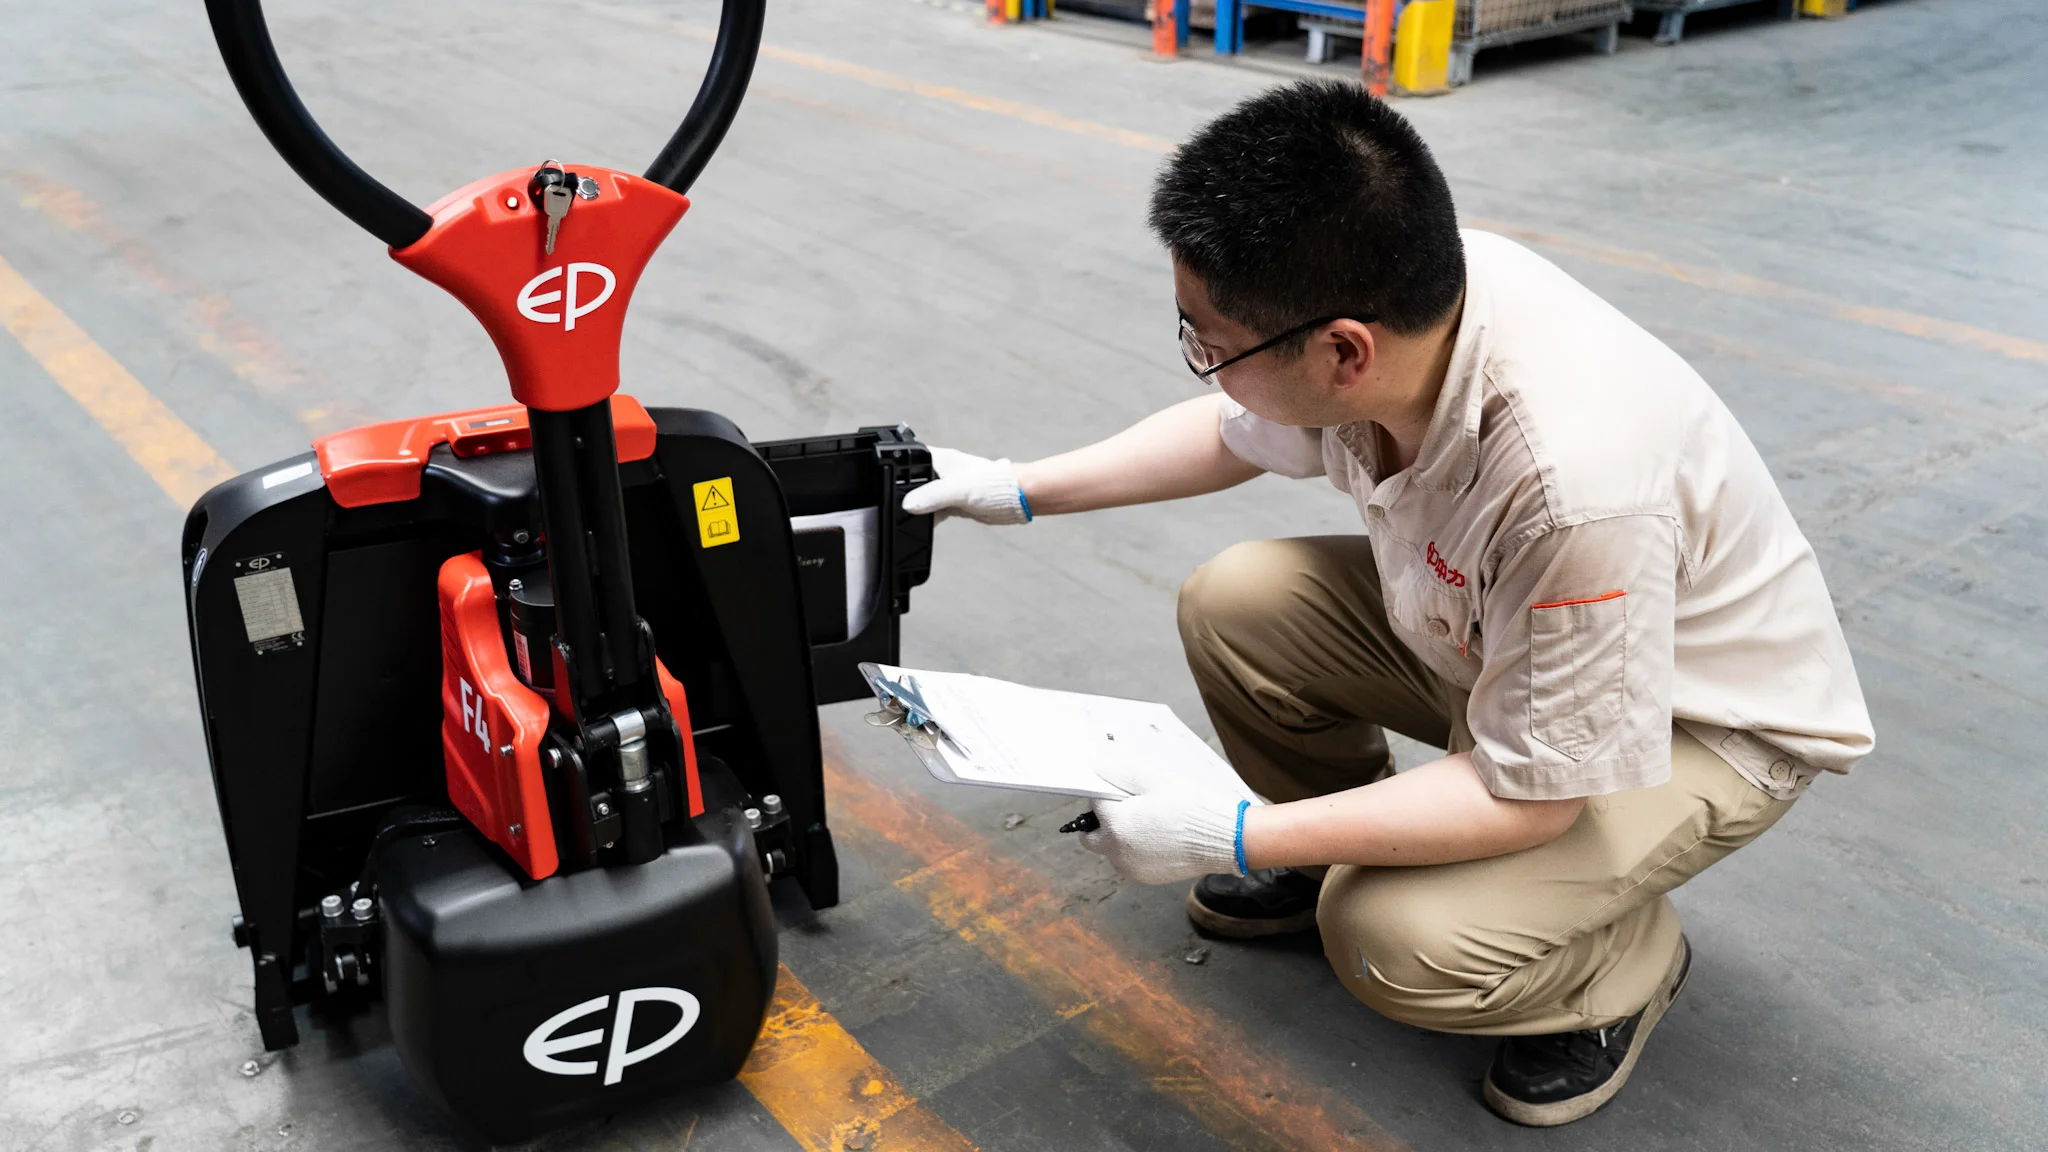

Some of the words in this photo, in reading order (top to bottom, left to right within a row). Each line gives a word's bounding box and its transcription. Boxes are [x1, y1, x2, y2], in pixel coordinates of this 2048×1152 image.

[516, 262, 616, 331] EP
[248, 557, 271, 570] EP
[460, 676, 491, 754] F4
[522, 986, 701, 1086] EP
